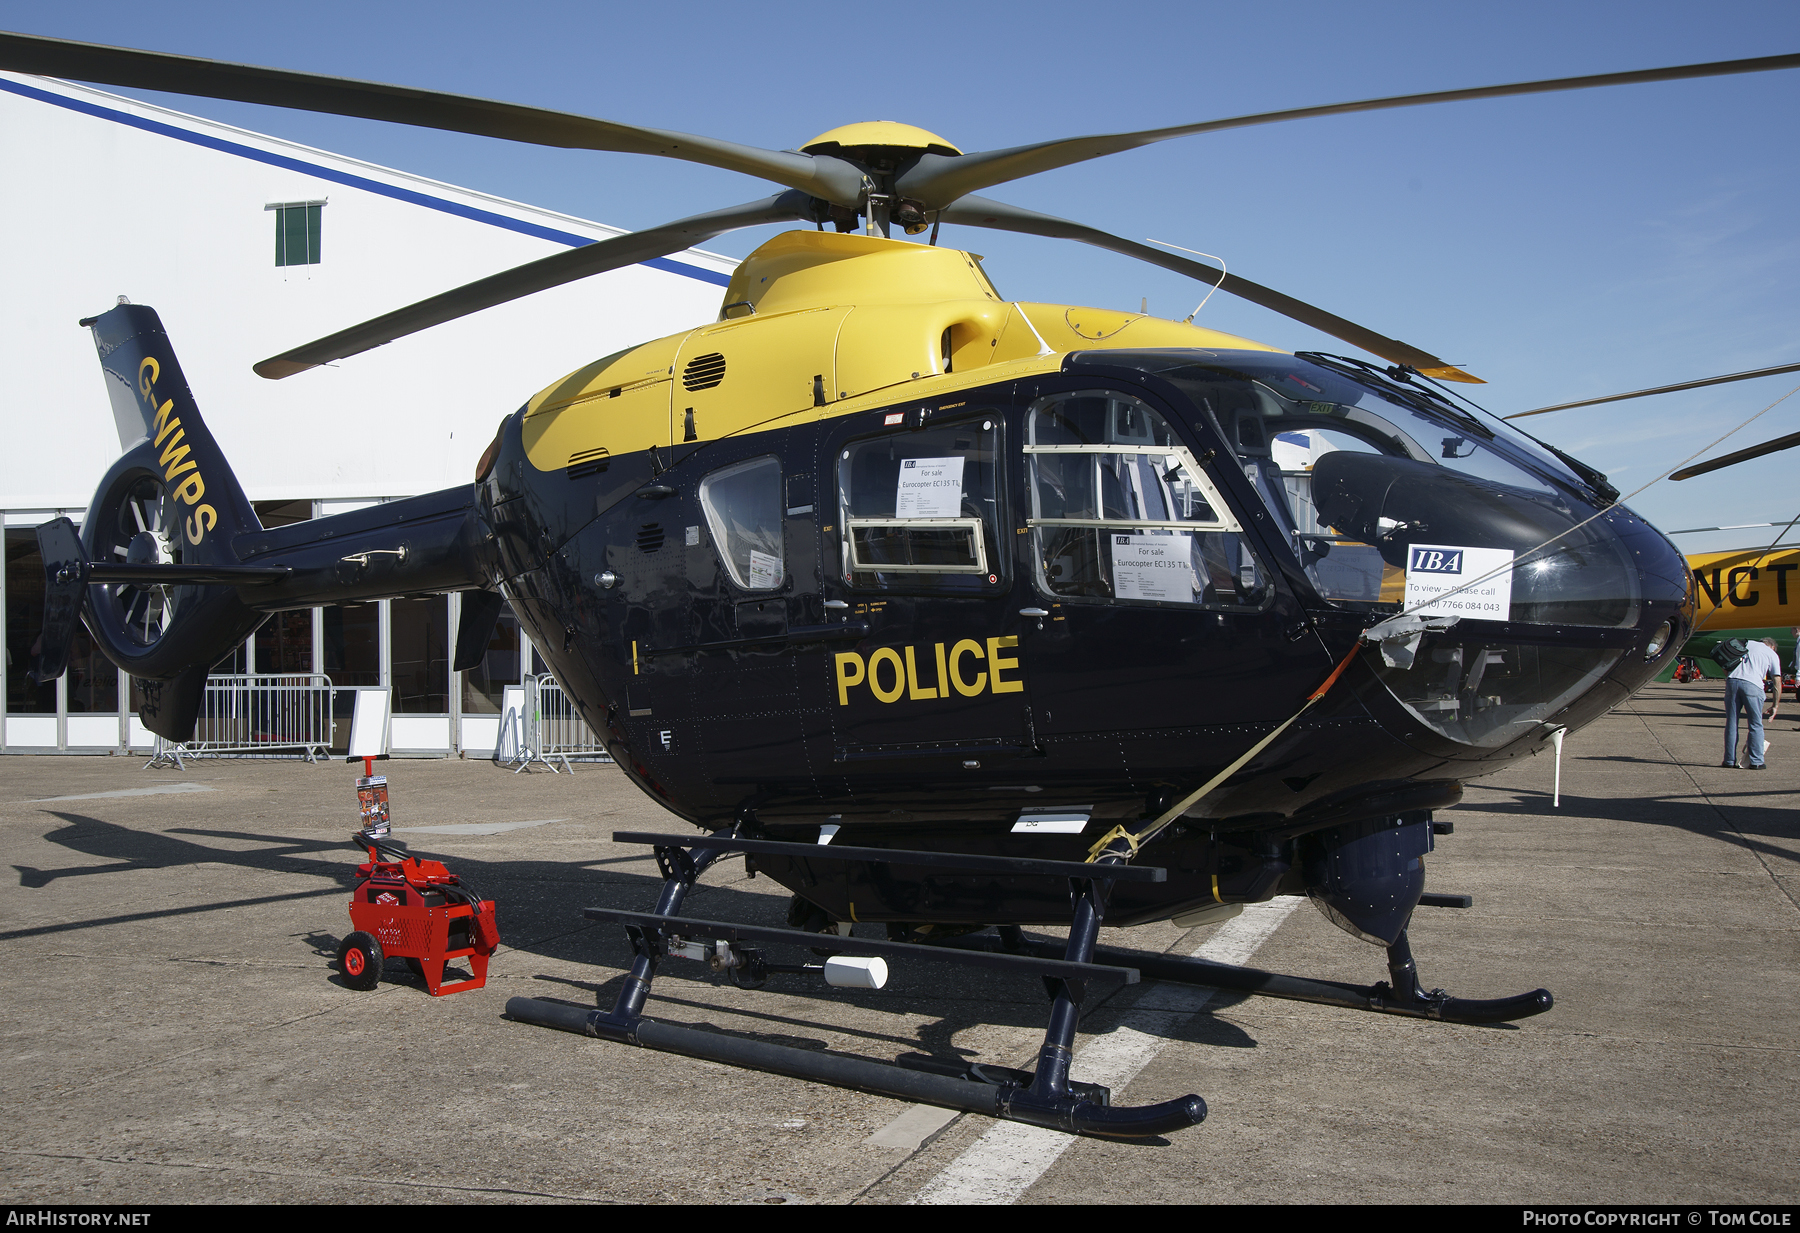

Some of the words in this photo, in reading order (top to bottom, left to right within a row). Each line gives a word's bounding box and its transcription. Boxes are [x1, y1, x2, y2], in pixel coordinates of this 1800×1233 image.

[1310, 403, 1332, 413] EXIT
[138, 356, 218, 546] G-NWPS
[1116, 537, 1129, 545] IBA
[1118, 560, 1152, 568] Eurocopter
[1414, 550, 1460, 572] IBA
[1442, 601, 1463, 609] 7766
[1484, 603, 1500, 611] 043
[835, 635, 1024, 706] POLICE
[660, 730, 672, 744] E
